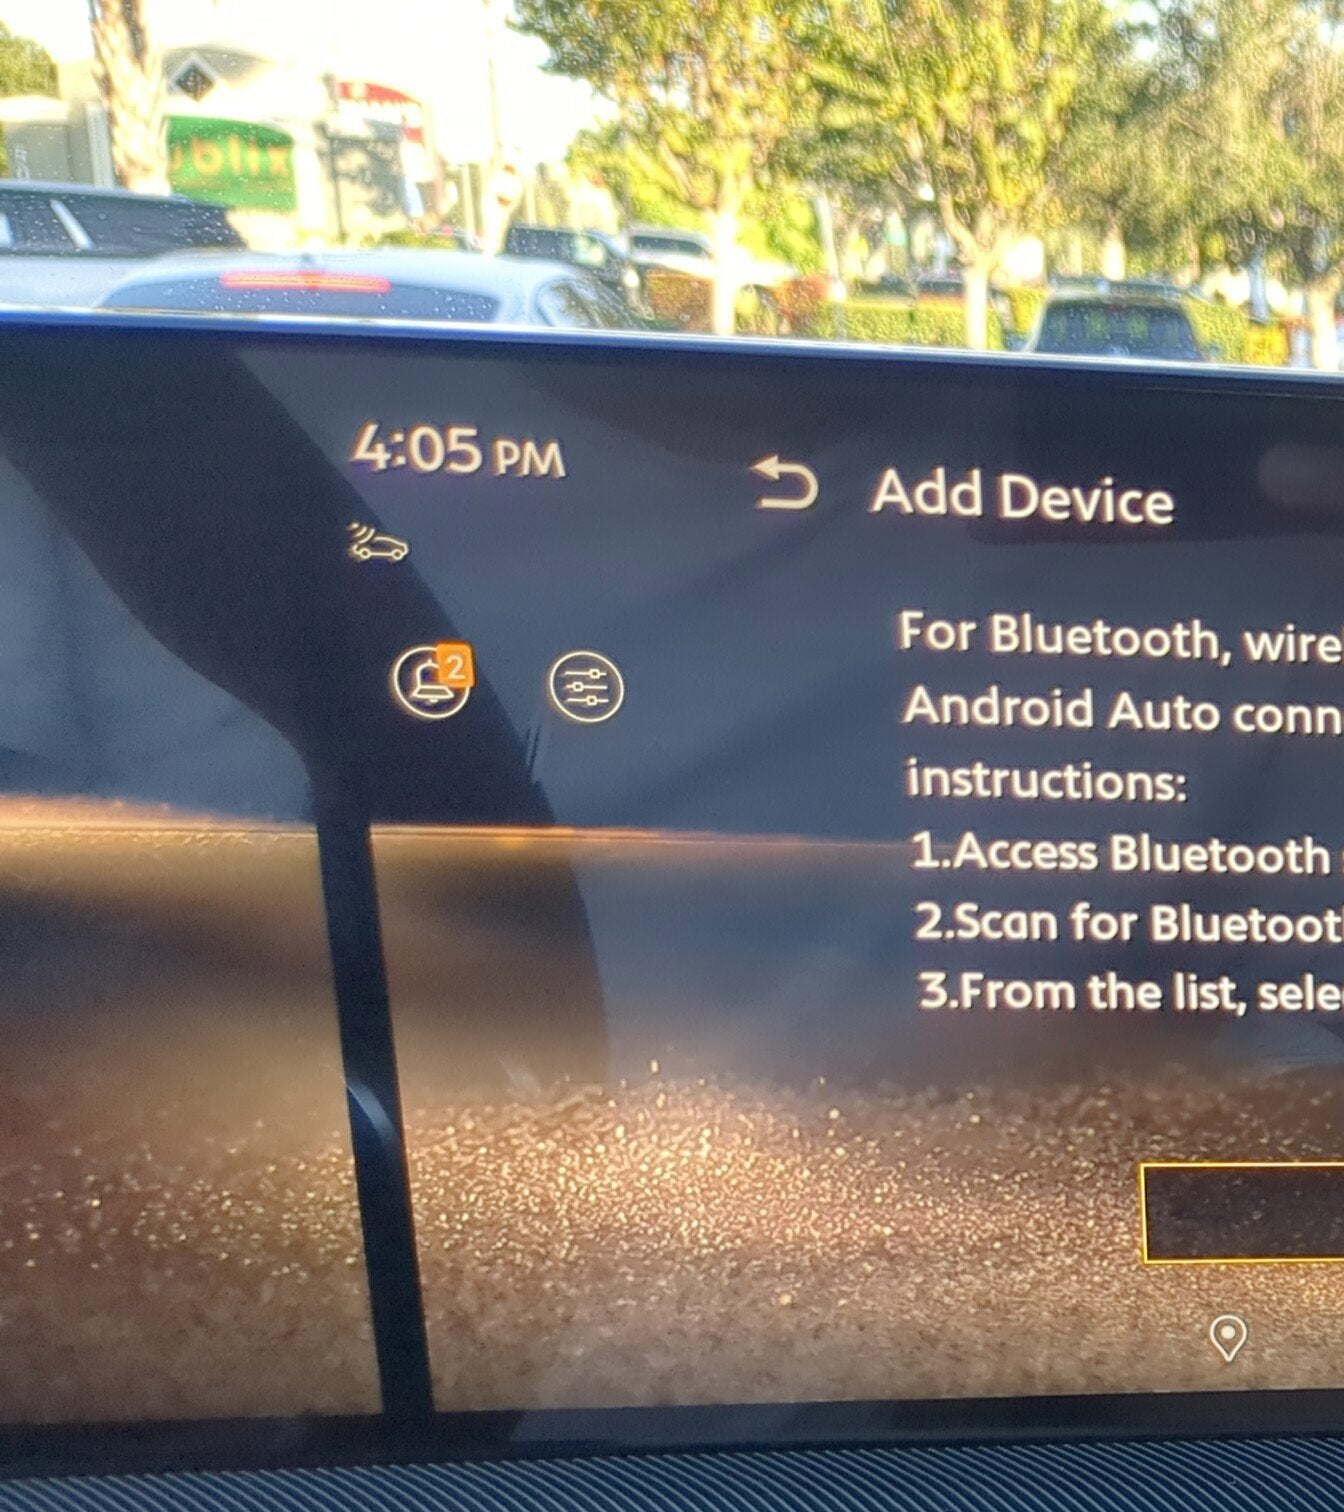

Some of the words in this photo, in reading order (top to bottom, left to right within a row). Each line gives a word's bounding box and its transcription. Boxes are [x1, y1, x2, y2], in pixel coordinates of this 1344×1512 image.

[352, 423, 483, 474] 4:05
[494, 439, 567, 478] PM
[871, 466, 983, 517] Add
[999, 473, 1175, 526] Device
[899, 609, 978, 652] For
[990, 612, 1232, 667] Bluetooth,
[445, 653, 467, 681] 2
[902, 684, 1094, 729] Android
[1107, 691, 1221, 732] Auto
[907, 756, 1187, 803] instructions:
[1110, 832, 1331, 875] Bluetooth
[1070, 901, 1140, 942] for
[1088, 970, 1163, 1011] the
[1174, 971, 1248, 1018] list,
